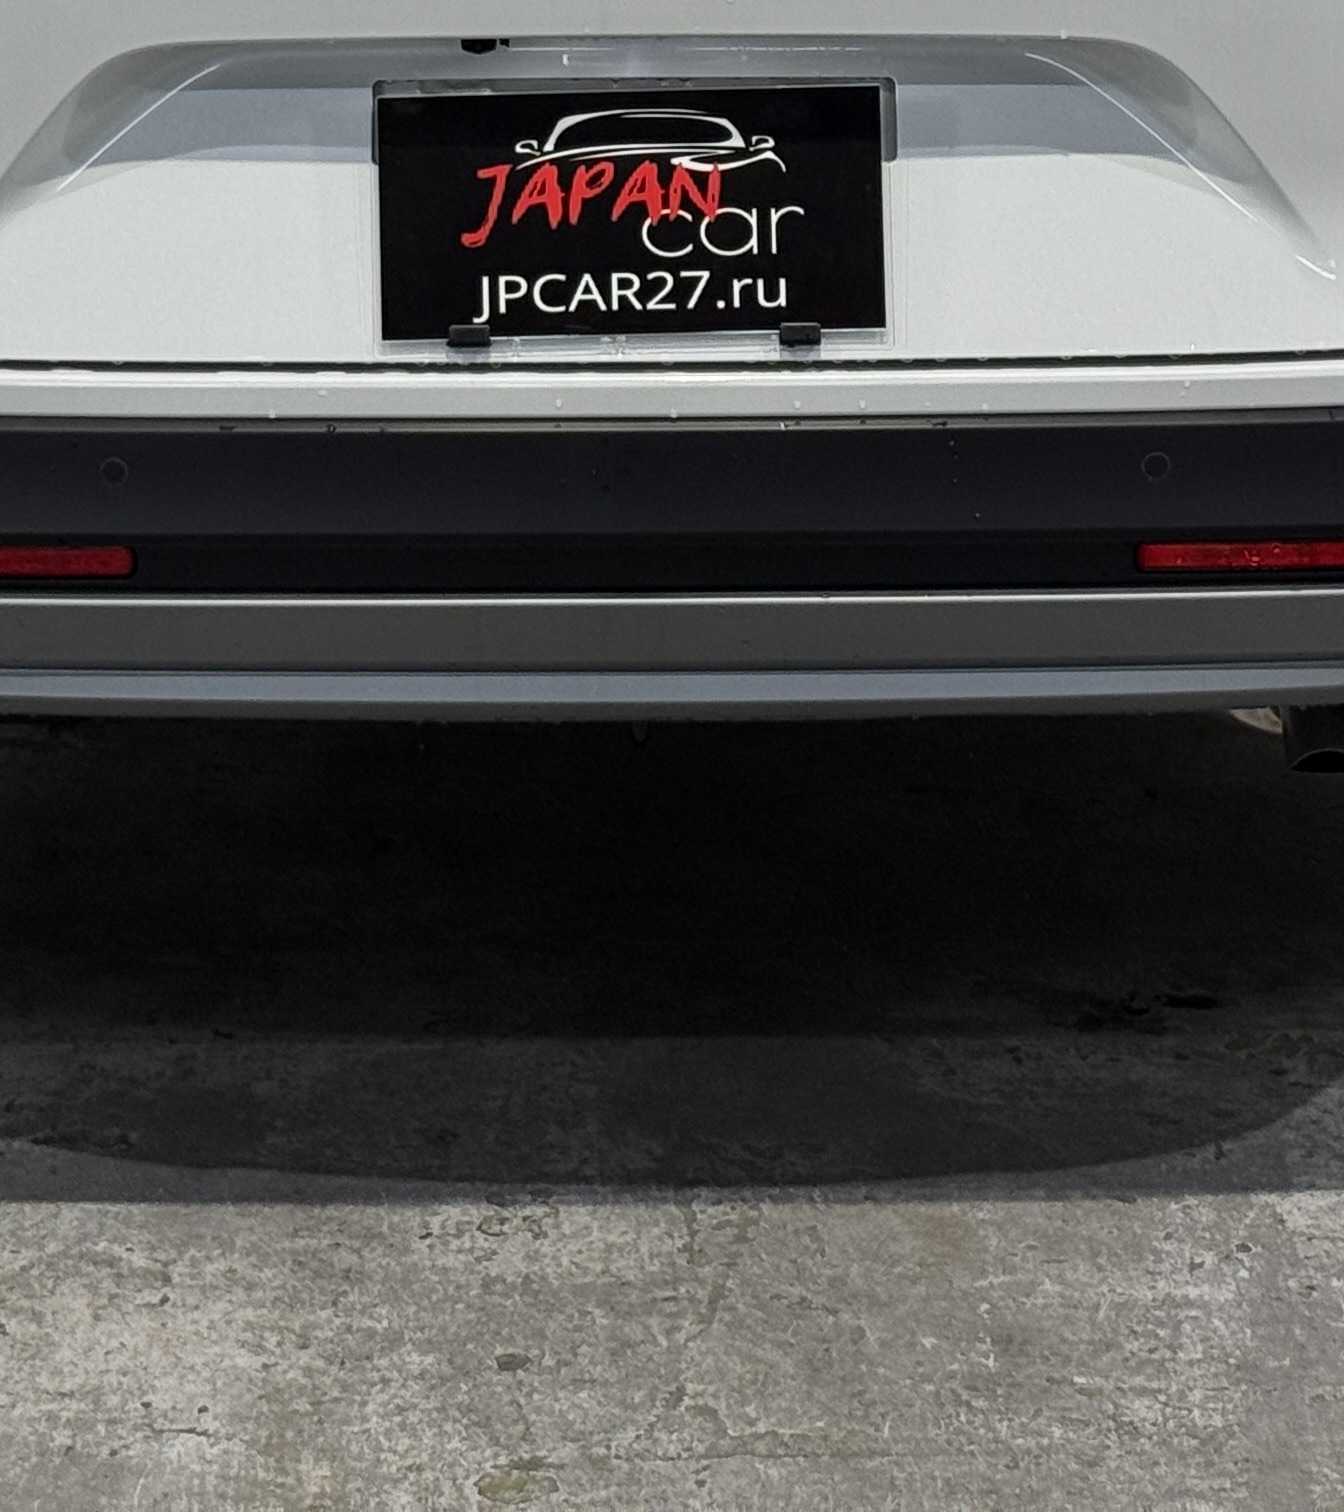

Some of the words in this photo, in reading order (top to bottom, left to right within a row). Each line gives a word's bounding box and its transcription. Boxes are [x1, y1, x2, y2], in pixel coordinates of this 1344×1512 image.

[459, 160, 722, 248] JAPAN
[641, 204, 806, 258] car
[472, 270, 788, 324] JPCAR27.ru
